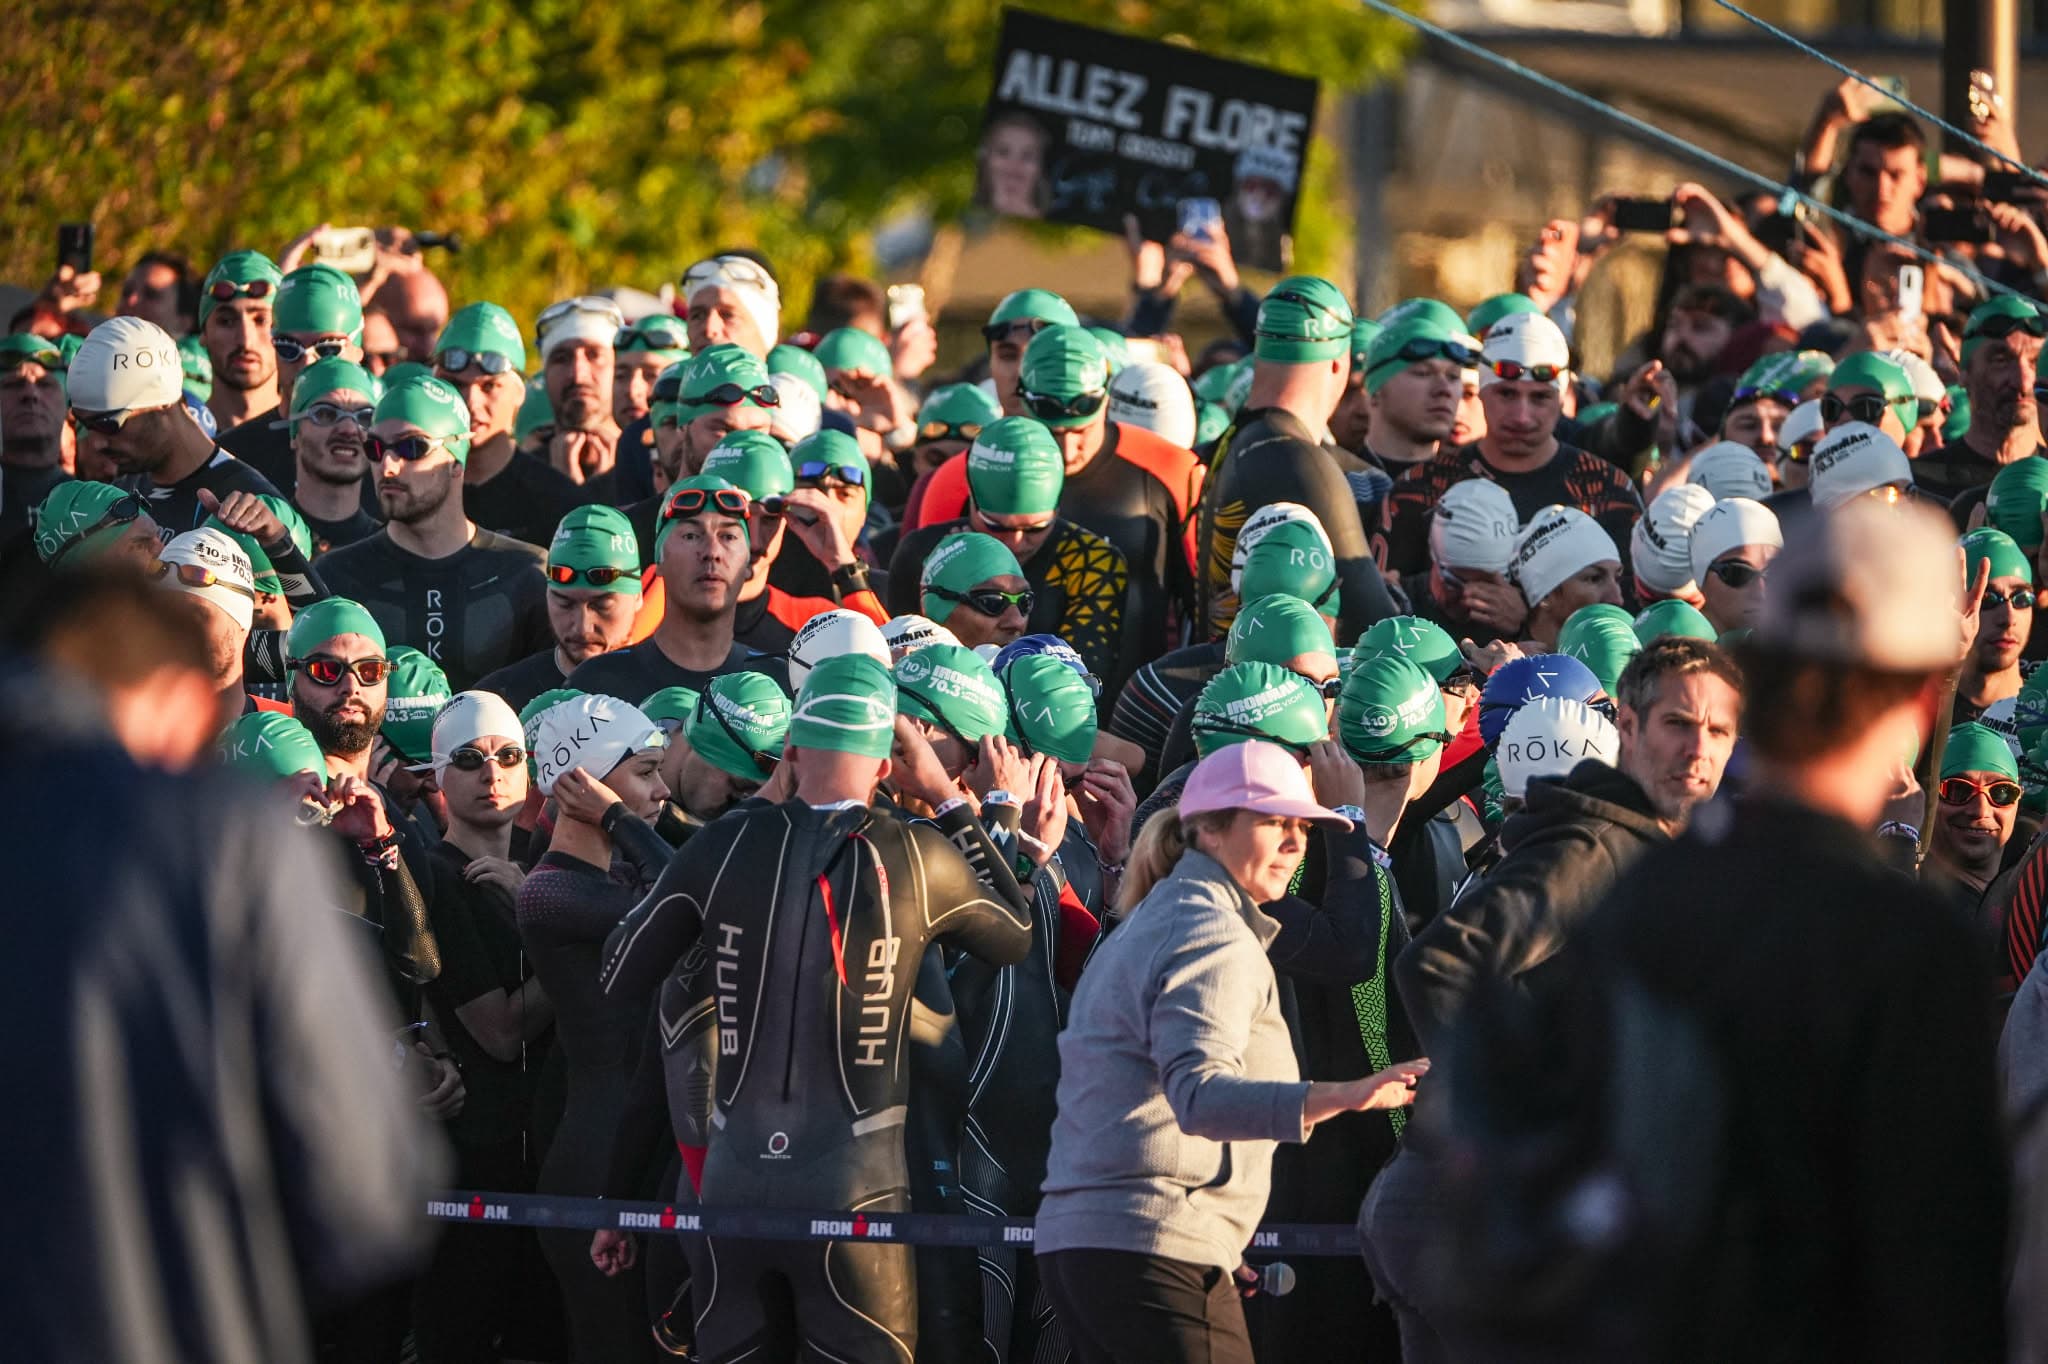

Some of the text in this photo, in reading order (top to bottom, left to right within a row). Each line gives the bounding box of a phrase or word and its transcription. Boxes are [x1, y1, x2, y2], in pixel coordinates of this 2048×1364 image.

[997, 49, 1307, 153] ALLEZ FLORE
[426, 589, 444, 660] RŌK
[928, 677, 962, 698] 70.3
[1226, 680, 1300, 716] IRONMAN
[386, 710, 409, 722] 0.3
[746, 725, 771, 736] VICHY
[716, 922, 743, 1056] HUUB
[855, 937, 901, 1065] HUUB
[427, 1195, 508, 1220] IRONMAN
[618, 1206, 700, 1230] IRONMAN
[811, 1214, 892, 1237] IRONMAN
